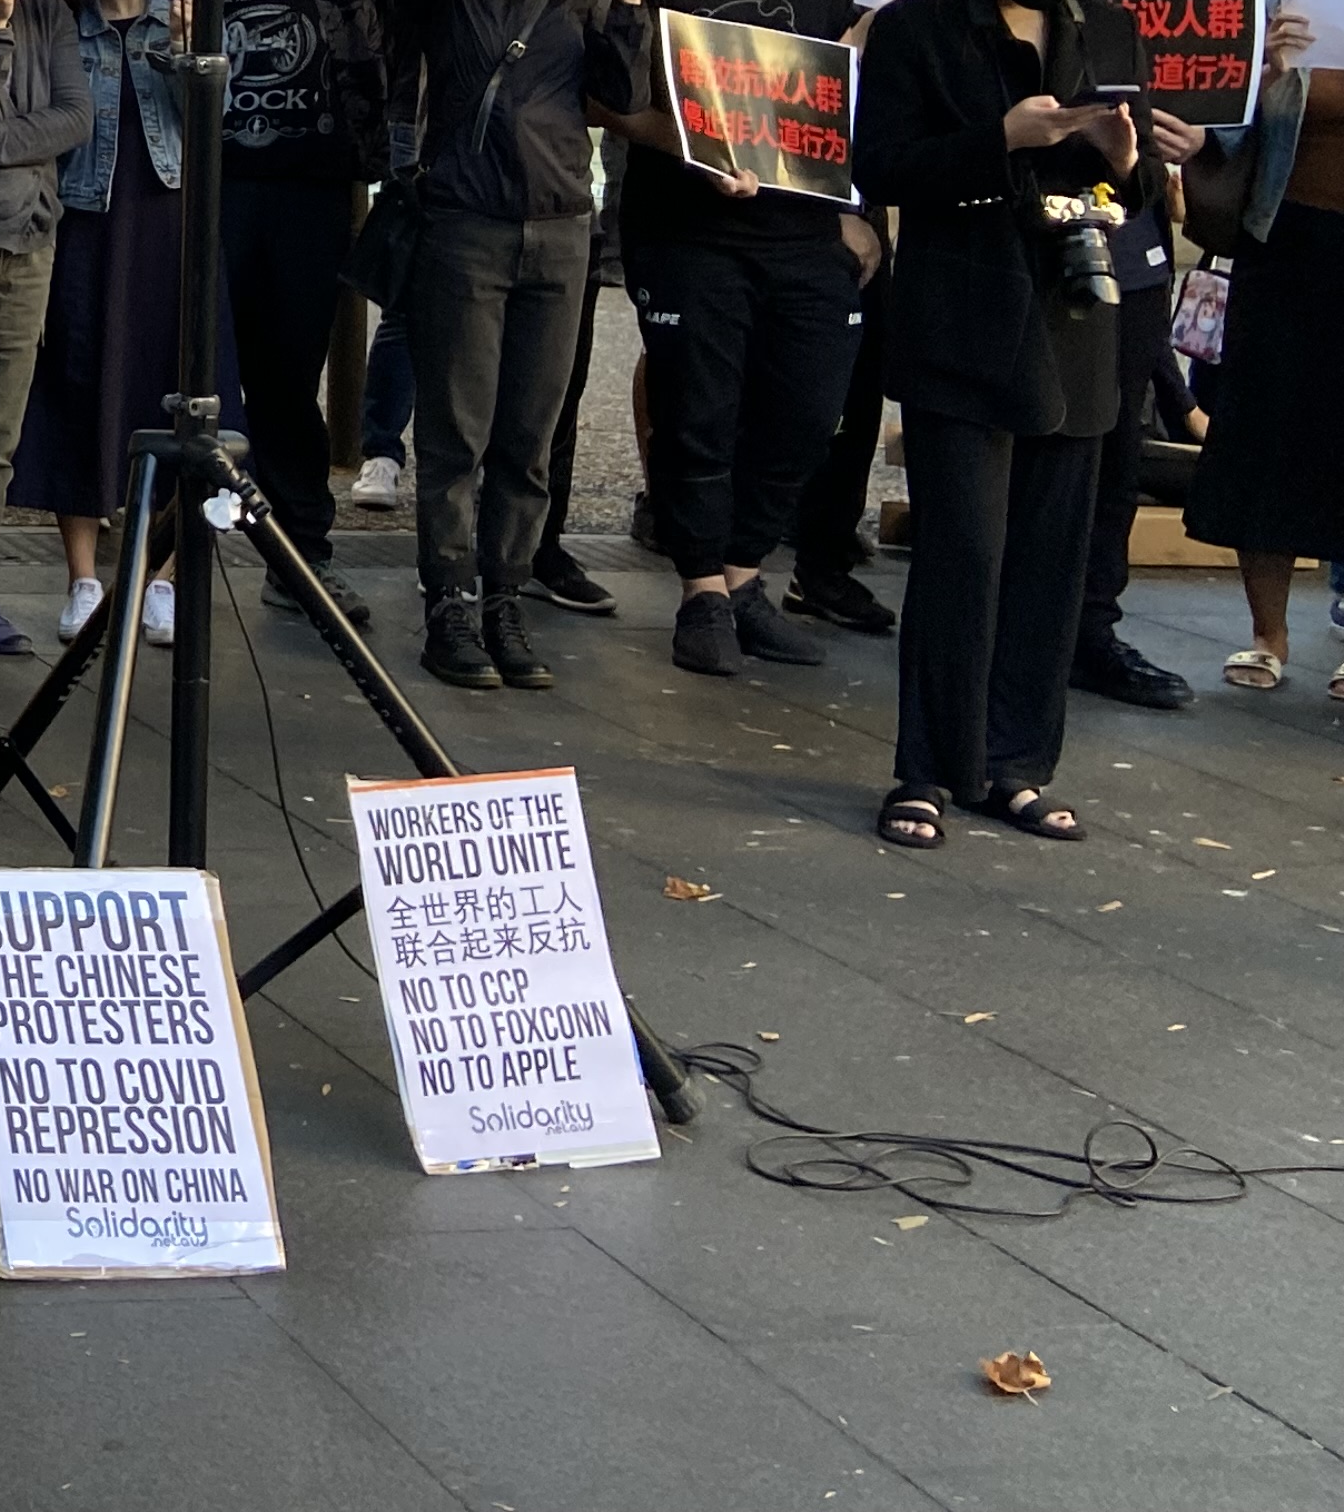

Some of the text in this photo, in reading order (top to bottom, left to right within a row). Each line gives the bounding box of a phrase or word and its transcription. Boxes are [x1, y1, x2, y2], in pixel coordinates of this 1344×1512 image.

[679, 48, 843, 115] 释放抗议人群
[1148, 54, 1248, 91] 道行为
[227, 88, 308, 111] OCK
[683, 97, 848, 165] 停止非人道行为
[368, 793, 568, 840] WORKERS OF THE
[374, 830, 576, 886] WORLD UNITE
[386, 880, 584, 932] 全世界的工人
[392, 918, 591, 969] 联合起来反抗
[56, 954, 206, 998] CHINESE
[398, 968, 529, 1015] NO TO CCP
[408, 1000, 612, 1055] NO TO FOXCONN
[56, 1058, 107, 1105] TO
[114, 1058, 226, 1105] COVID
[417, 1045, 582, 1097] NO TO APPLE
[5, 1106, 237, 1155] REPRESSION
[469, 1100, 594, 1134] Solidarity
[13, 1168, 248, 1203] NO WAR ON CHINA
[67, 1207, 208, 1246] Solidarity
